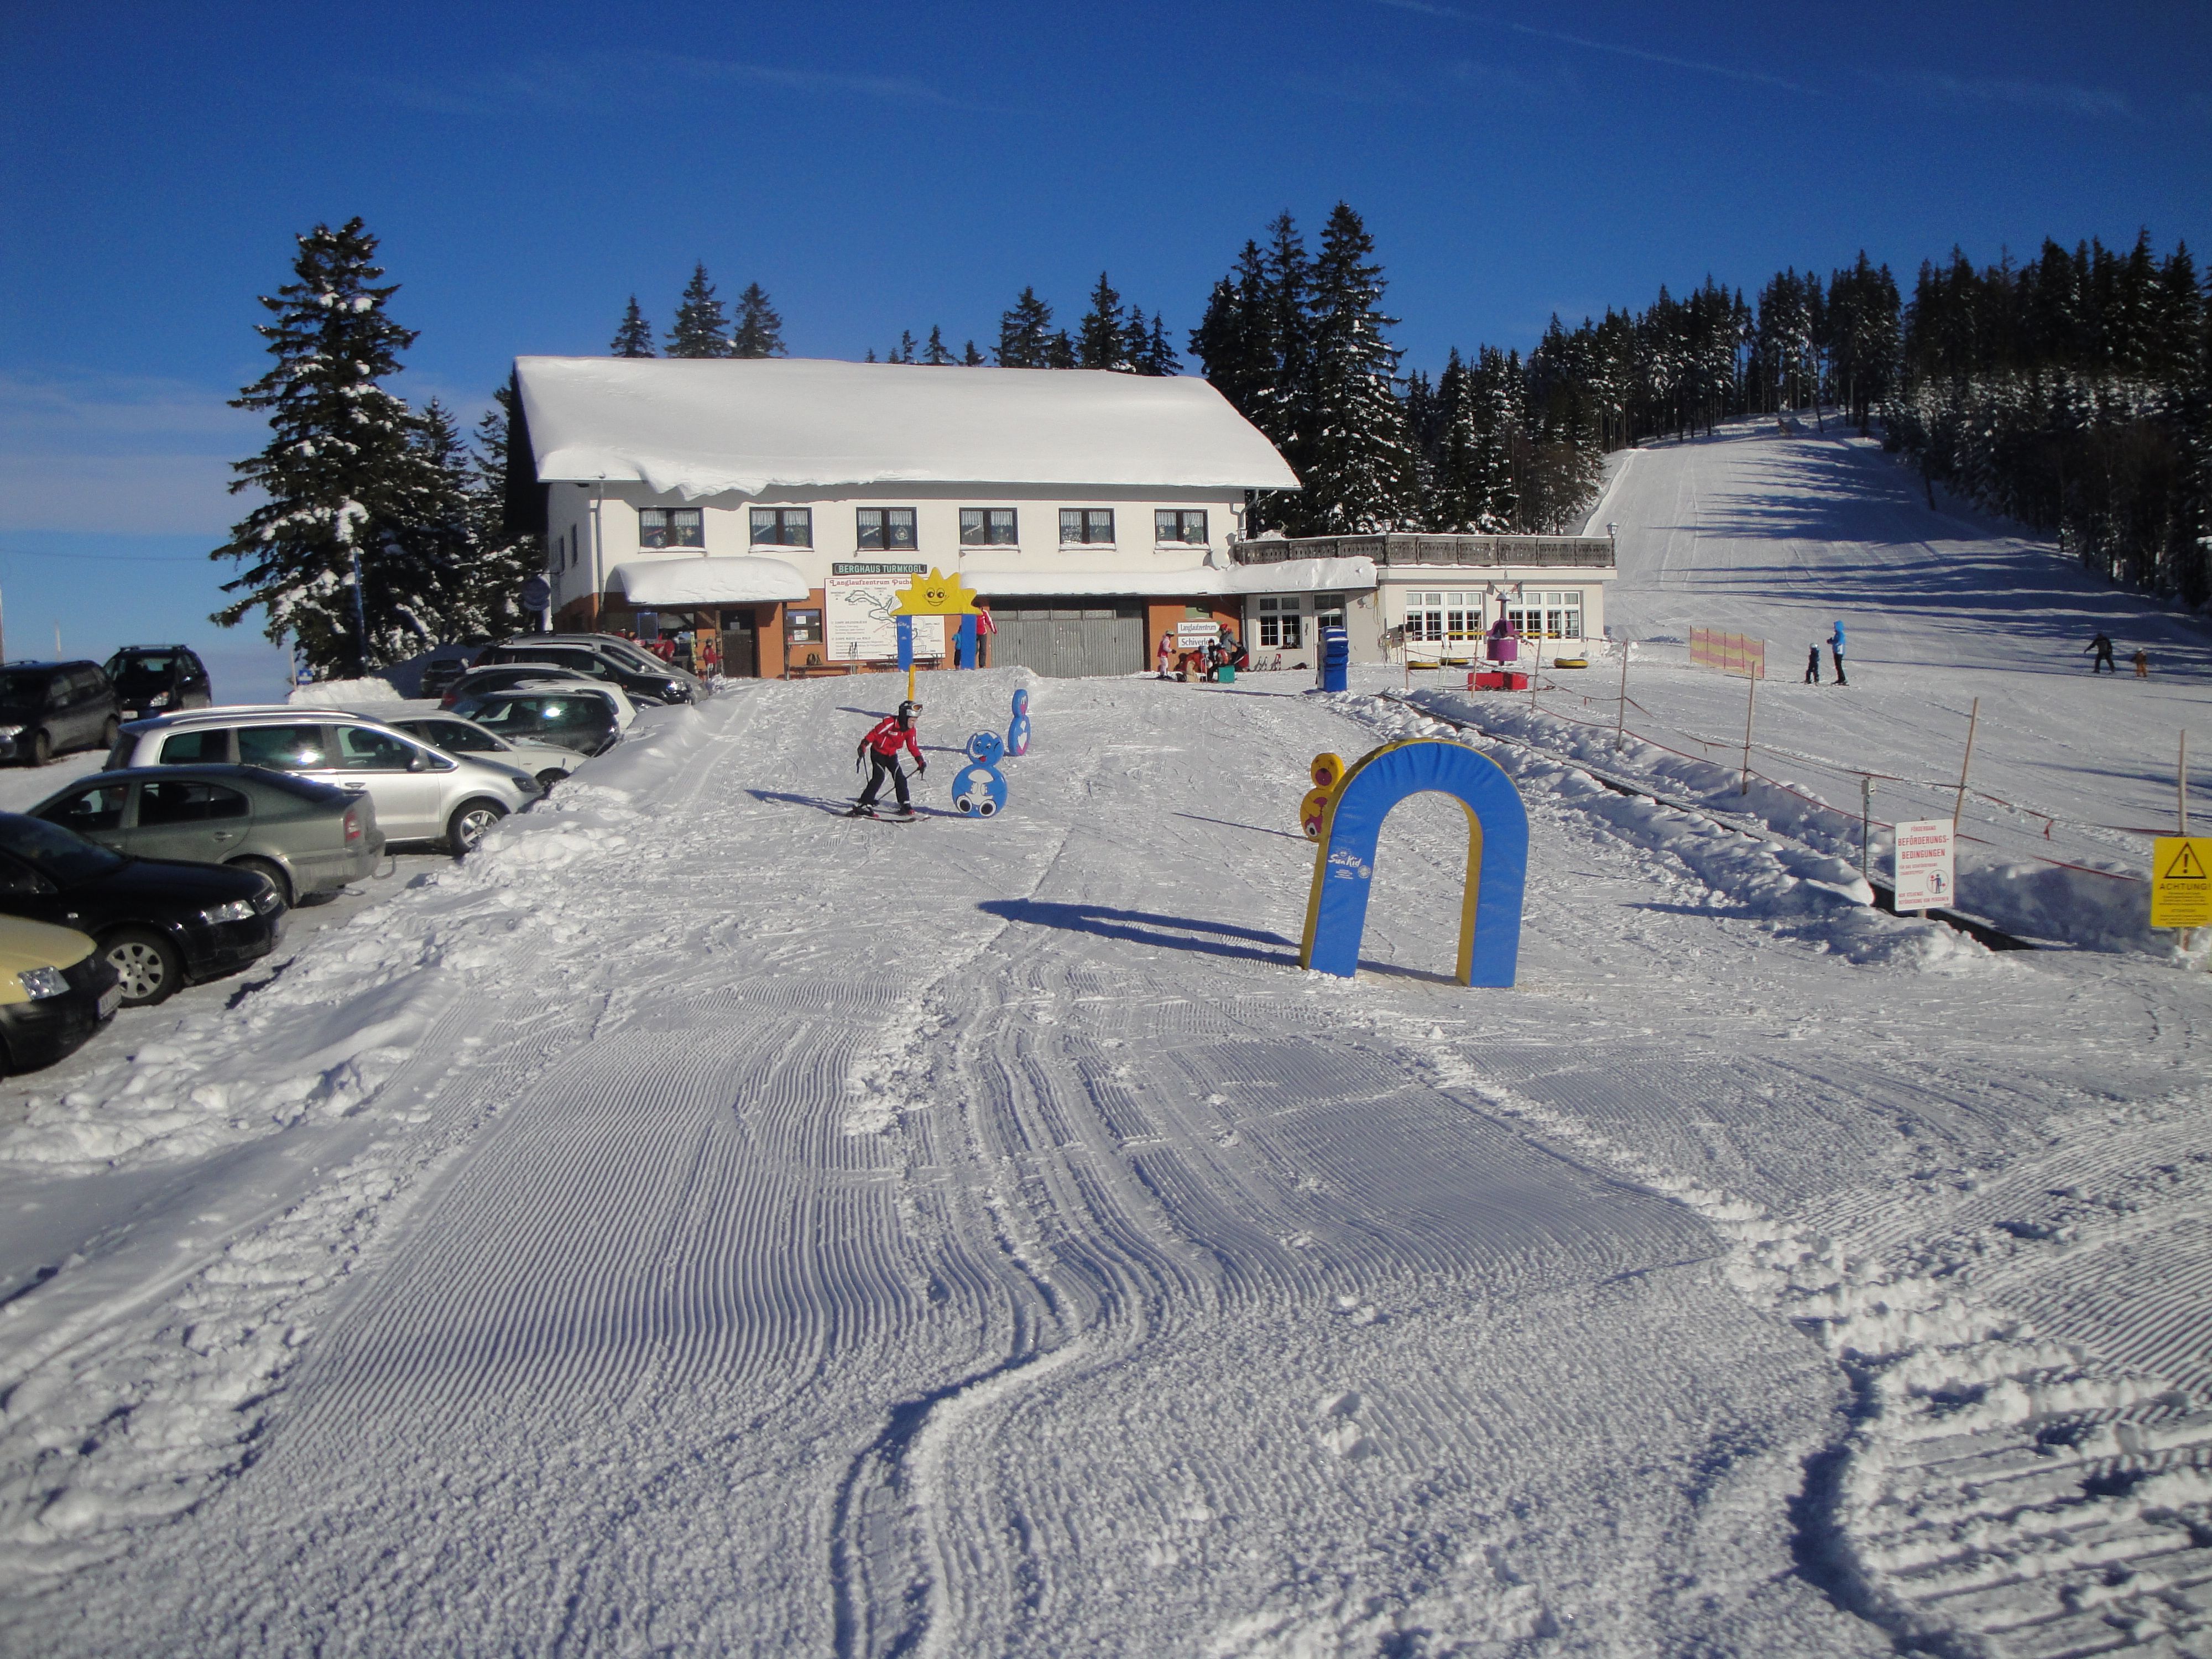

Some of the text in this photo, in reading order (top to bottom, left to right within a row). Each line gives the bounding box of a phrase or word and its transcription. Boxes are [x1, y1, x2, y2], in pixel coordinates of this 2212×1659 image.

[838, 565, 923, 573] BERGHAUS TURMKOGL
[1181, 624, 1216, 633] Langlaufzentrum
[1898, 836, 1949, 846] BEFÖRDERUNGS-
[1902, 849, 1945, 859] BEDINGUNGEN
